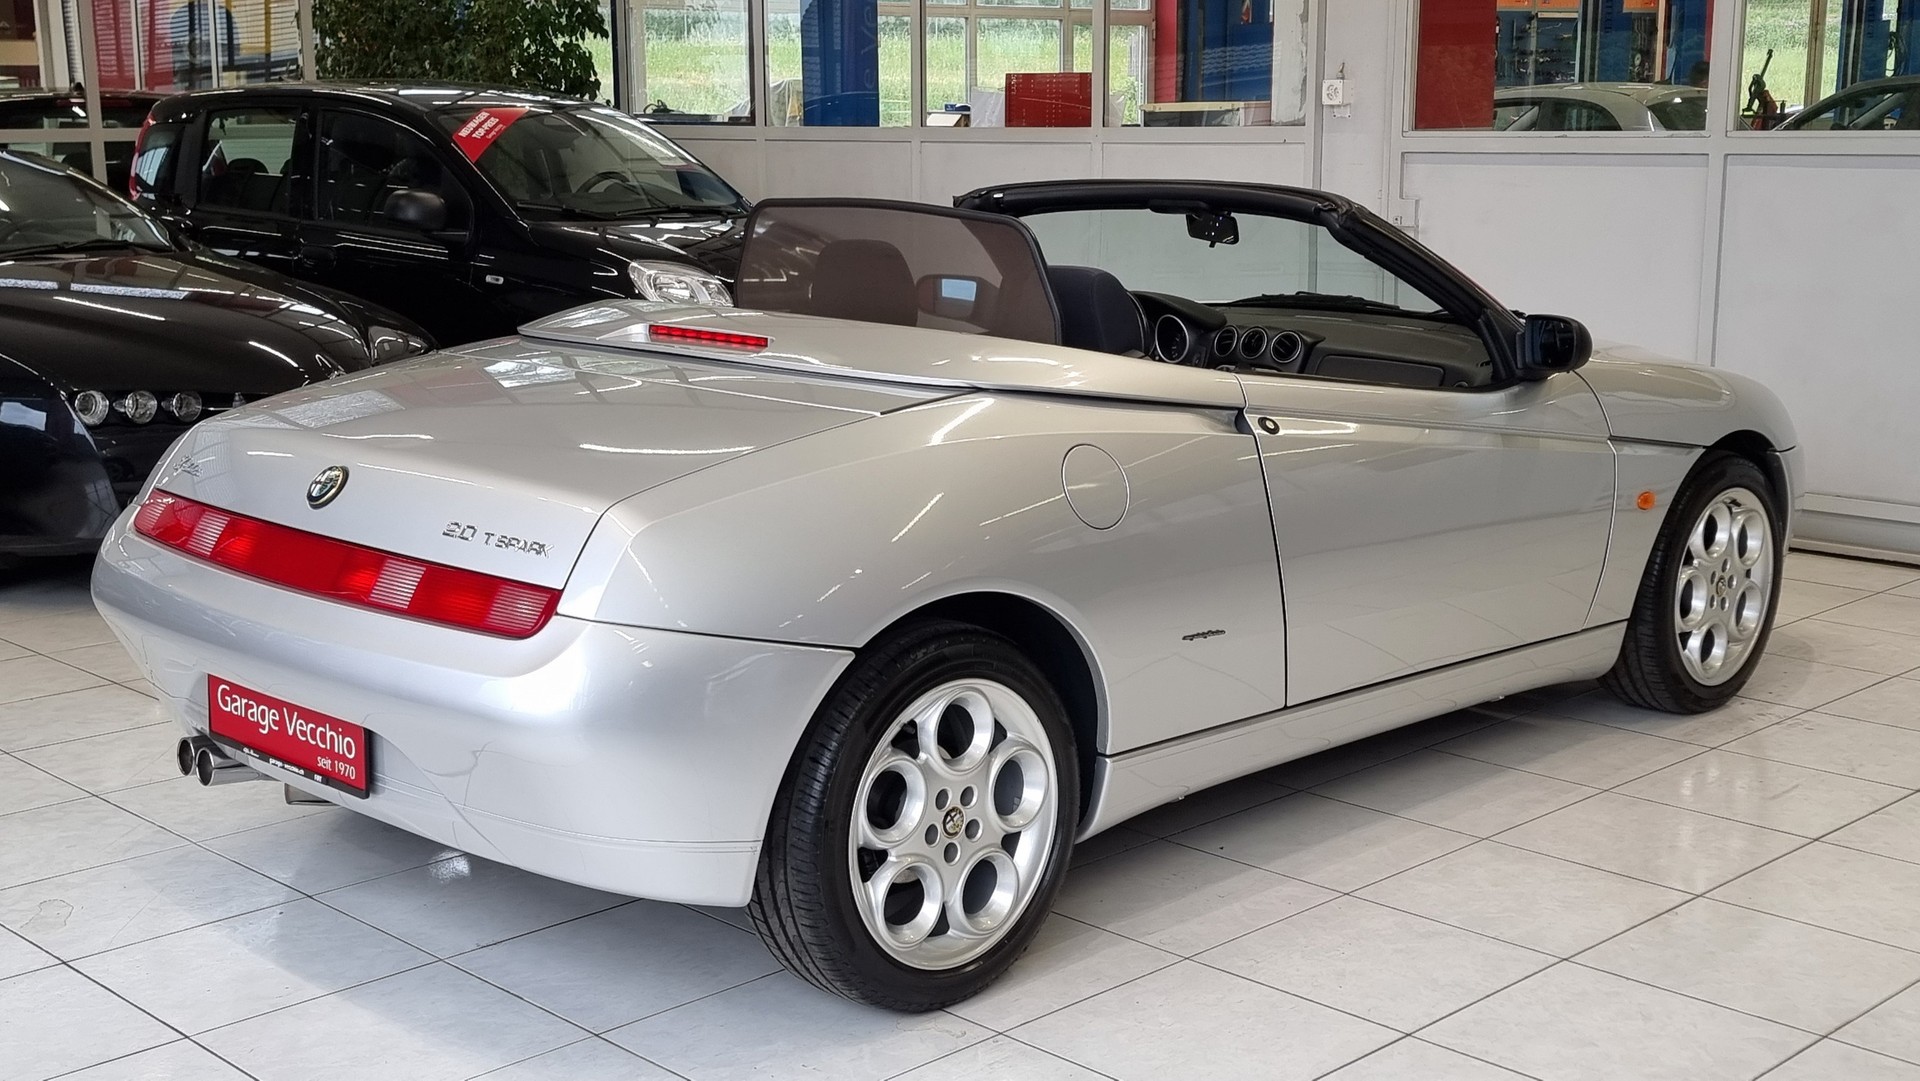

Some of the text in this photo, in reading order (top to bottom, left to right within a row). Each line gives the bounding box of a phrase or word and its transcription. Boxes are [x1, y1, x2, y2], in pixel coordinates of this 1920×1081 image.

[217, 684, 356, 759] Garage Vecchio
[317, 755, 332, 772] seit
[334, 760, 356, 780] 1970
